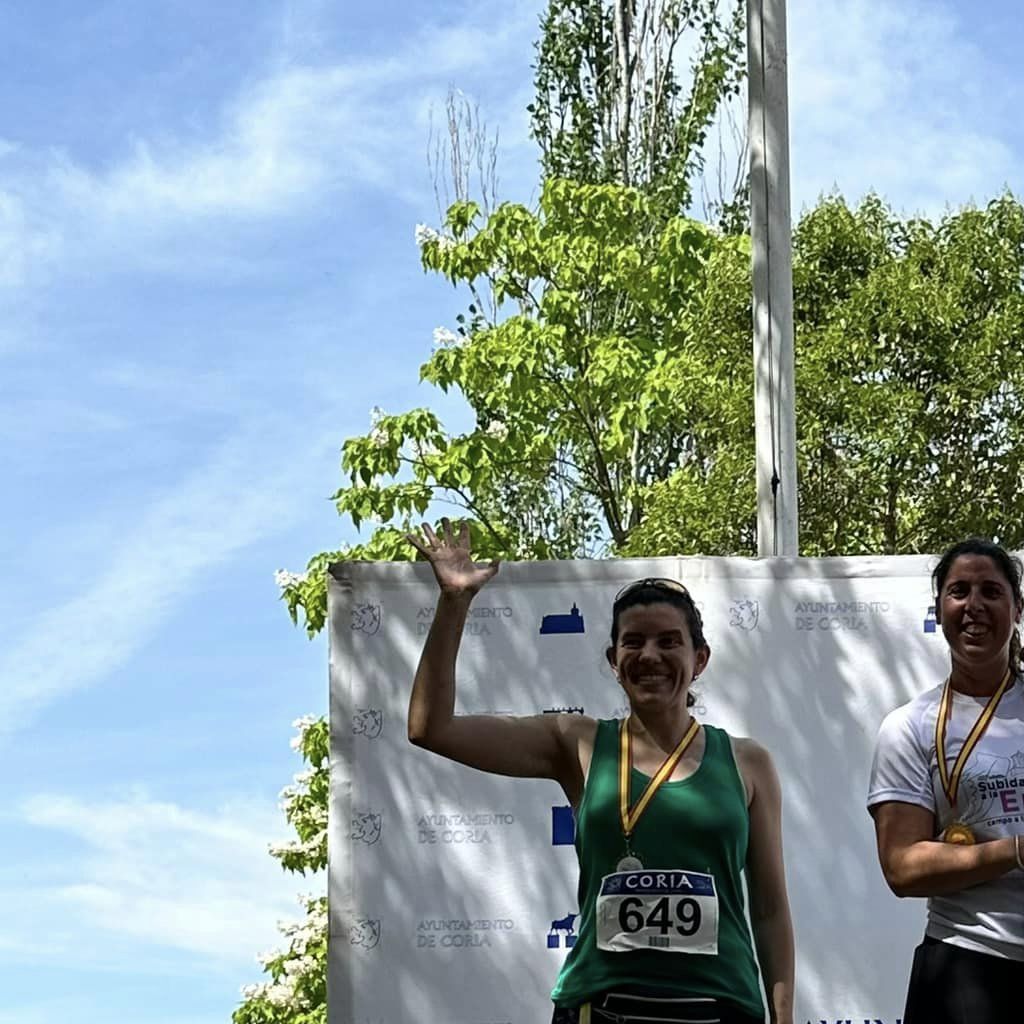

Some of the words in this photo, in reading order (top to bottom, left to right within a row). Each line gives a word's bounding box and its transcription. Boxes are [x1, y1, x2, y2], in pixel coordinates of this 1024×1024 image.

[795, 601, 890, 614] AYUNTAMIENTO
[795, 617, 815, 631] DE
[817, 616, 868, 631] CORIA
[416, 813, 515, 826] AYUNTAMIENTO
[417, 830, 437, 844] DE
[442, 830, 492, 844] CORIA
[625, 874, 693, 889] CORIA
[618, 896, 702, 936] 649
[416, 919, 514, 931] AYUNTAMIENTO
[416, 934, 436, 948] DE
[440, 934, 492, 947] CORIA
